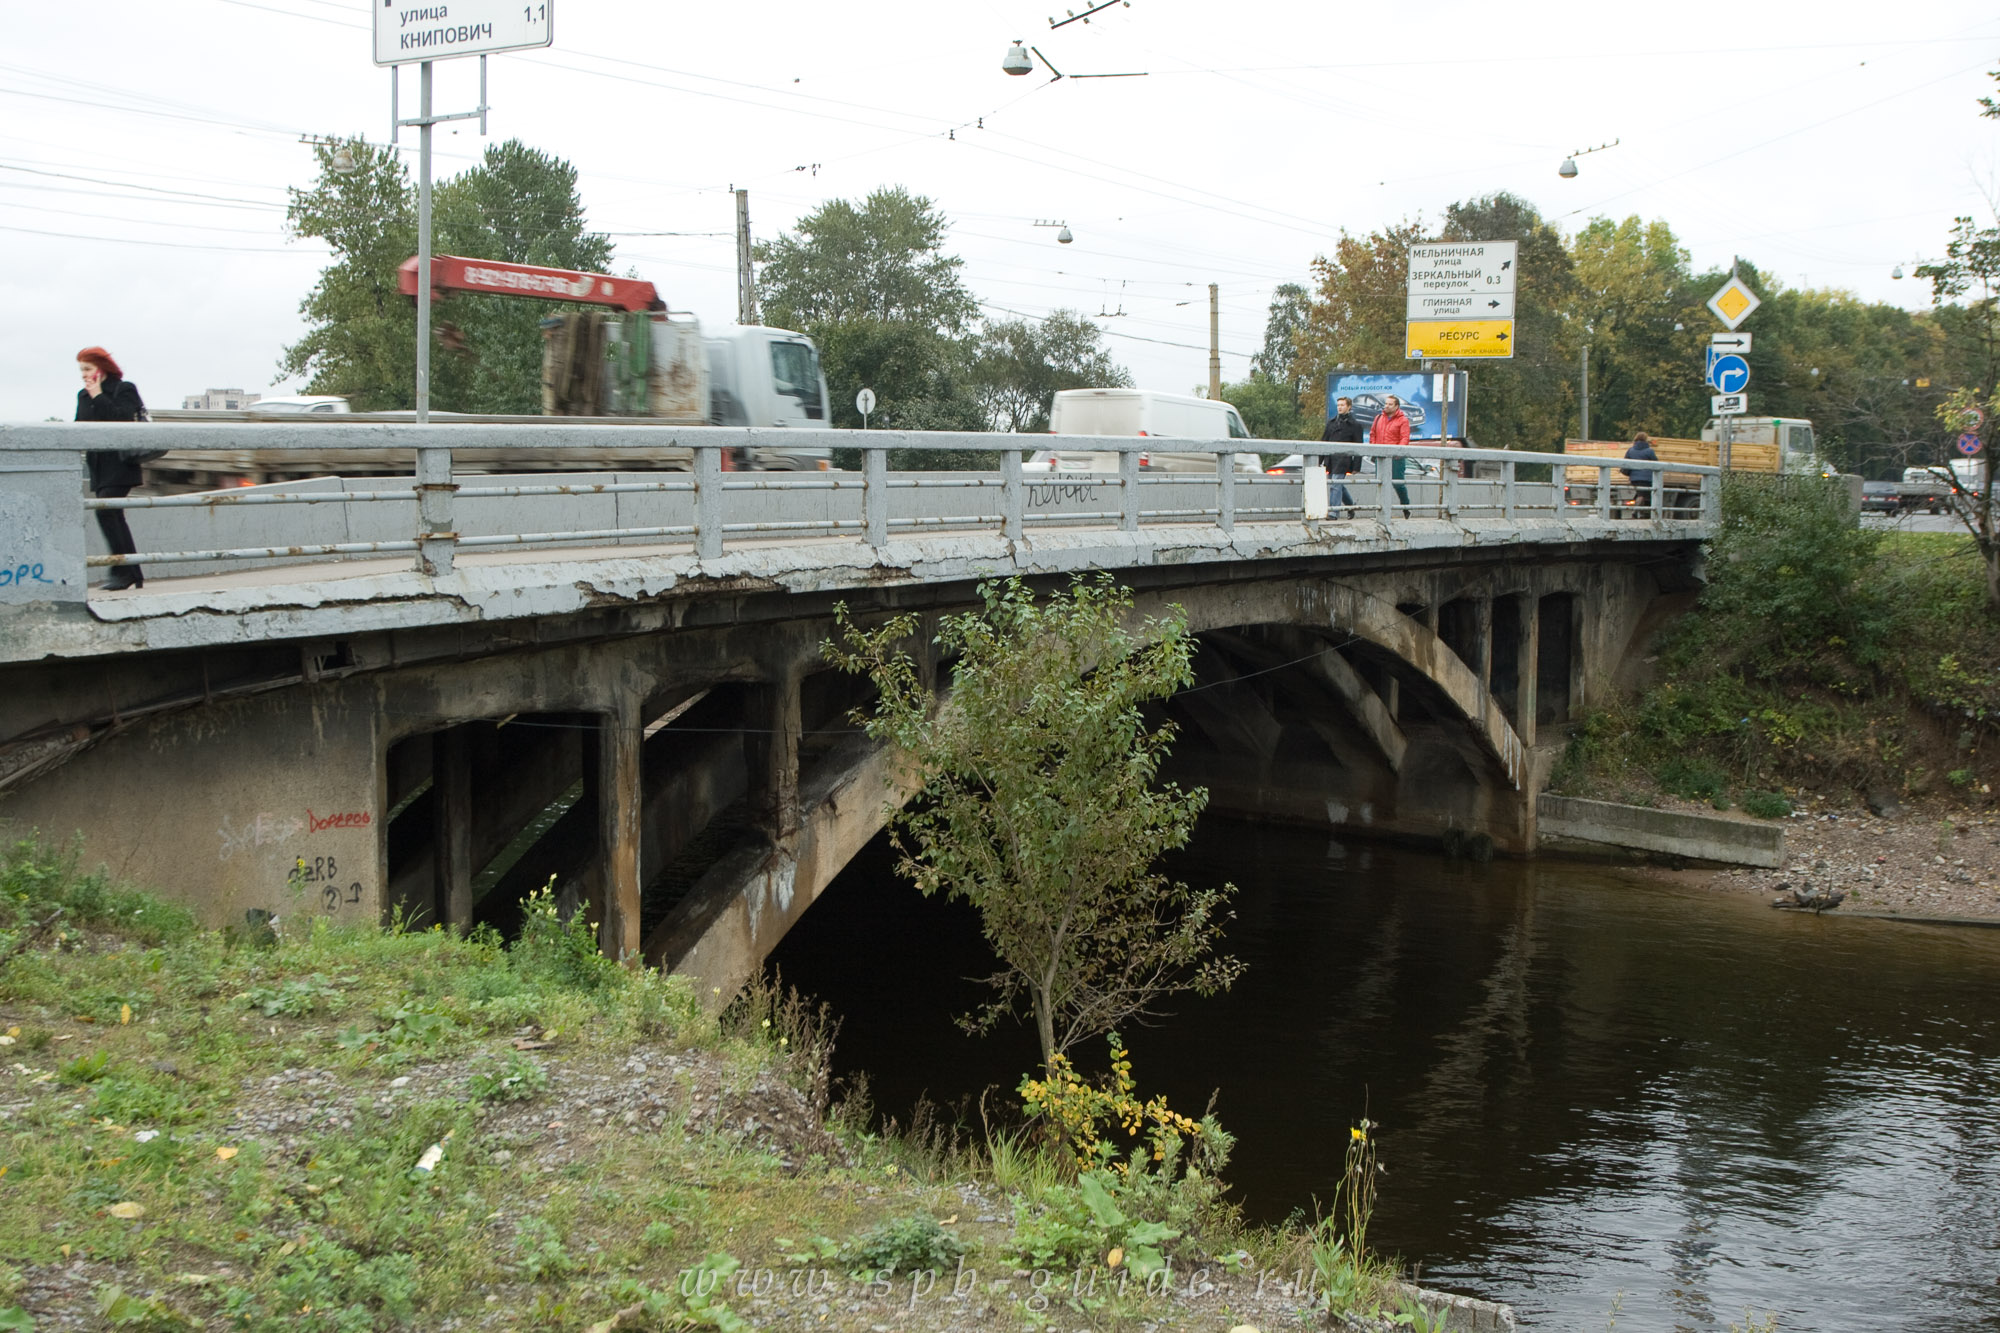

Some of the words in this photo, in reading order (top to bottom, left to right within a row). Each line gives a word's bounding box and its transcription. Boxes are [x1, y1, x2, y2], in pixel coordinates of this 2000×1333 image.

[400, 6, 447, 27] улица
[524, 4, 545, 24] 1,1
[400, 23, 492, 50] КНИПОВИЧ
[1413, 247, 1484, 258] МЕЛЬНИЧНАЯ
[1433, 259, 1462, 268] улица
[1412, 268, 1482, 280] ЗЕРКАЛЬНЫЙ
[1423, 280, 1469, 289] переулок
[1422, 298, 1472, 307] ГЛИНЯНАЯ
[1433, 307, 1460, 315] улица
[1439, 331, 1480, 341] РЕСУРС
